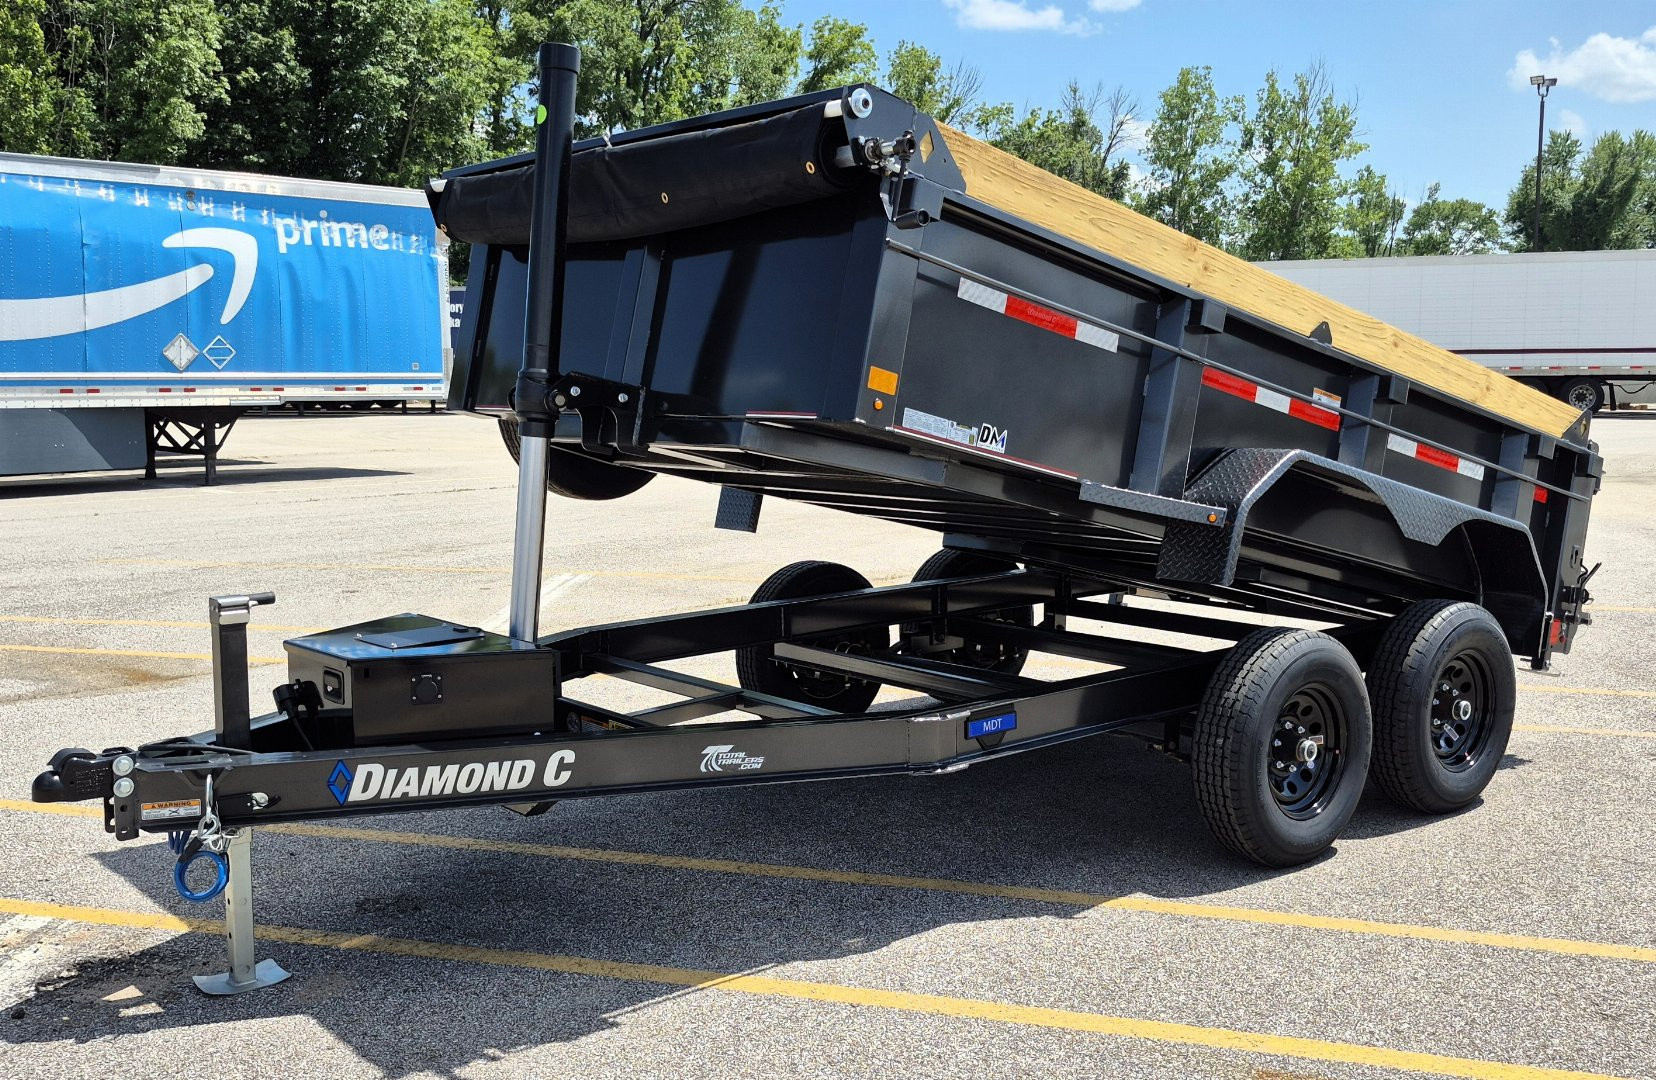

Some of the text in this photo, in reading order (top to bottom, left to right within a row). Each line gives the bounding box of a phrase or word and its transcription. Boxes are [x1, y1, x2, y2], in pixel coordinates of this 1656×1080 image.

[275, 210, 390, 254] prime
[983, 718, 1003, 732] MDT
[717, 756, 765, 766] TRAILERS
[718, 751, 748, 759] TOTAL
[348, 749, 576, 802] DIAMOND C
[157, 800, 192, 809] WARNING
